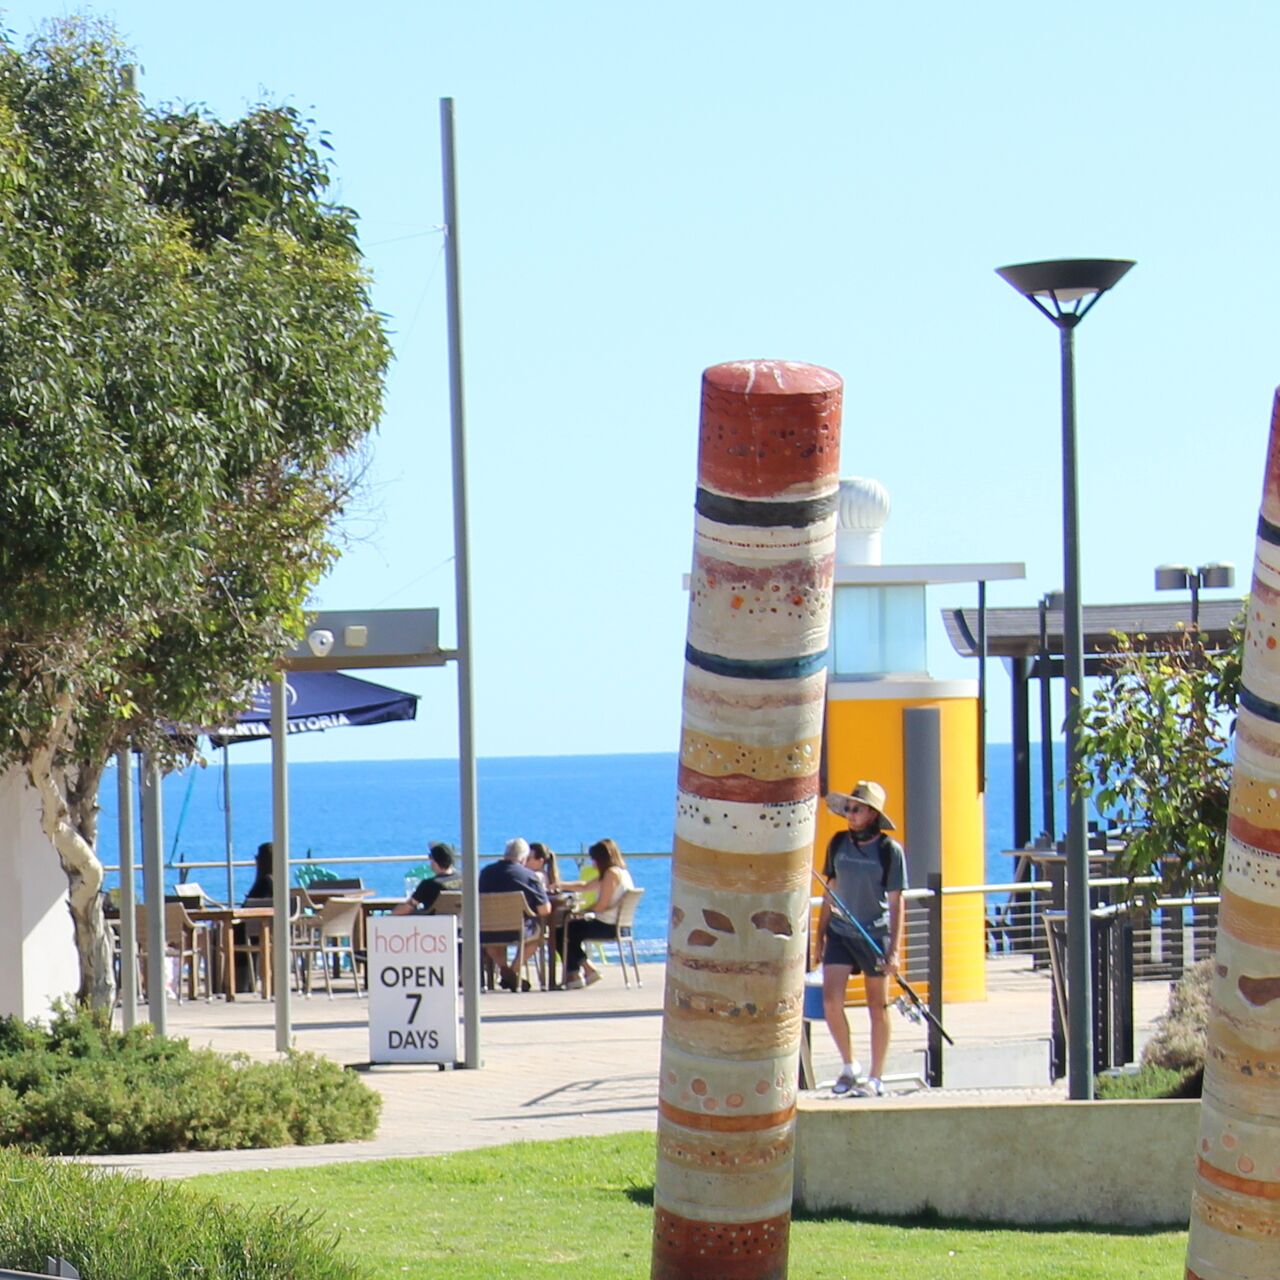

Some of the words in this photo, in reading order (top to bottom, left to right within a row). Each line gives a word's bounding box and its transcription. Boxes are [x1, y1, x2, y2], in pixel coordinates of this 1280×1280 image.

[286, 712, 352, 734] TTORIA
[374, 926, 448, 954] hortas
[380, 966, 445, 988] OPEN
[405, 993, 423, 1025] 7
[388, 1030, 439, 1050] DAYS
